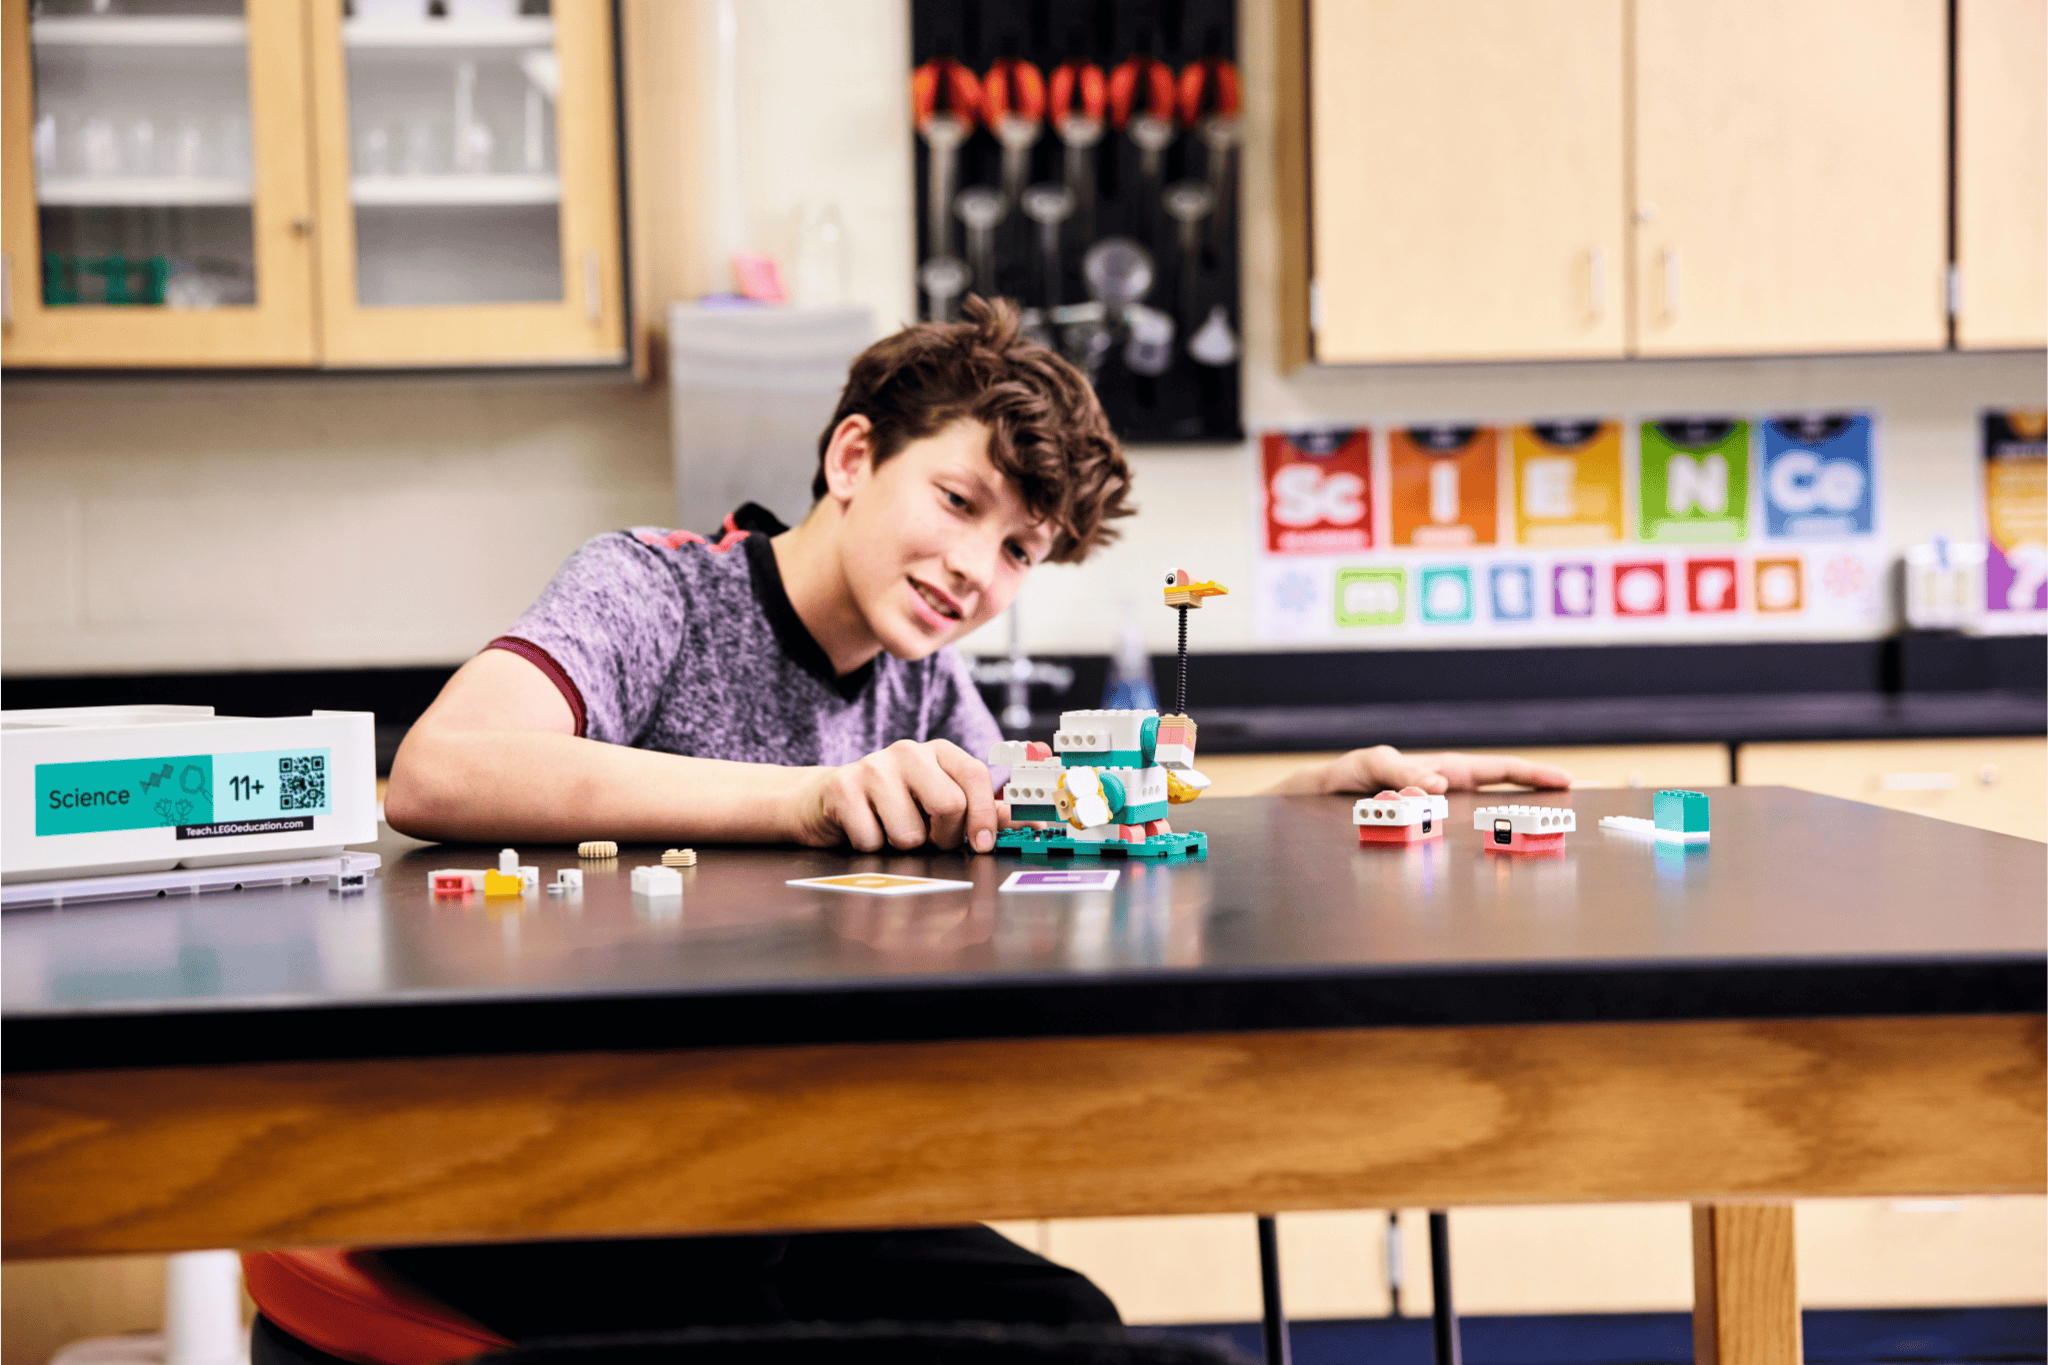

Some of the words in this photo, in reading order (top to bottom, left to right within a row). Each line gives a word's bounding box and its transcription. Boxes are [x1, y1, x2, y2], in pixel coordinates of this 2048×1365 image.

[49, 788, 131, 809] Science
[229, 775, 265, 801] 11+
[185, 819, 304, 838] Teach.LEGOeducation.com
